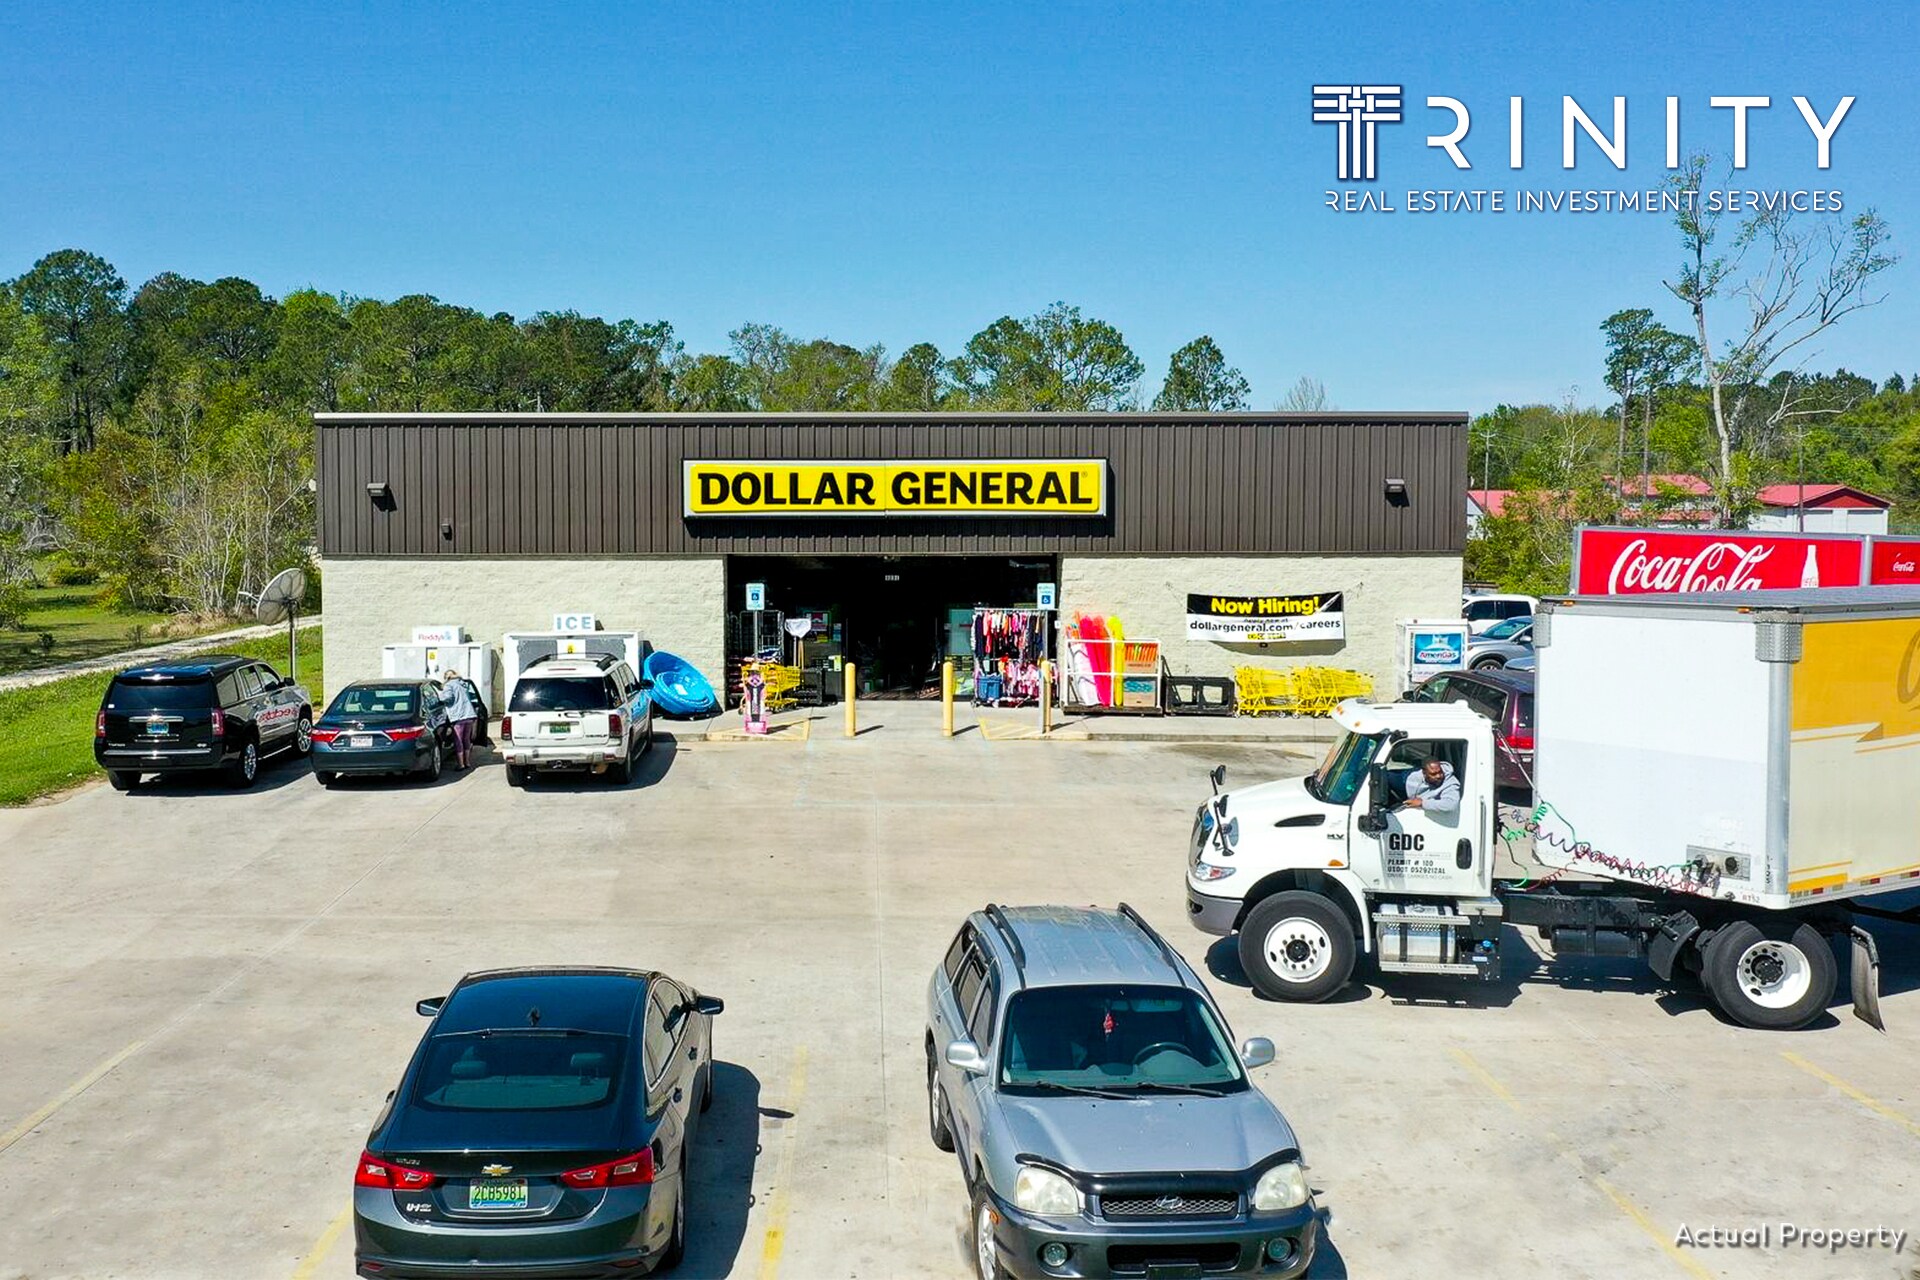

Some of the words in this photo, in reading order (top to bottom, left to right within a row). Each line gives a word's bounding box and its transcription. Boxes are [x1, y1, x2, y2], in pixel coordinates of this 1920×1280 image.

[698, 472, 876, 505] DOLLAR
[891, 471, 1092, 505] GENERAL
[1211, 597, 1253, 614] Now
[1258, 596, 1320, 616] Hiring!
[556, 616, 592, 630] ICE
[1190, 620, 1341, 633] dollargeneral.com/careers
[1389, 833, 1425, 851] GDC
